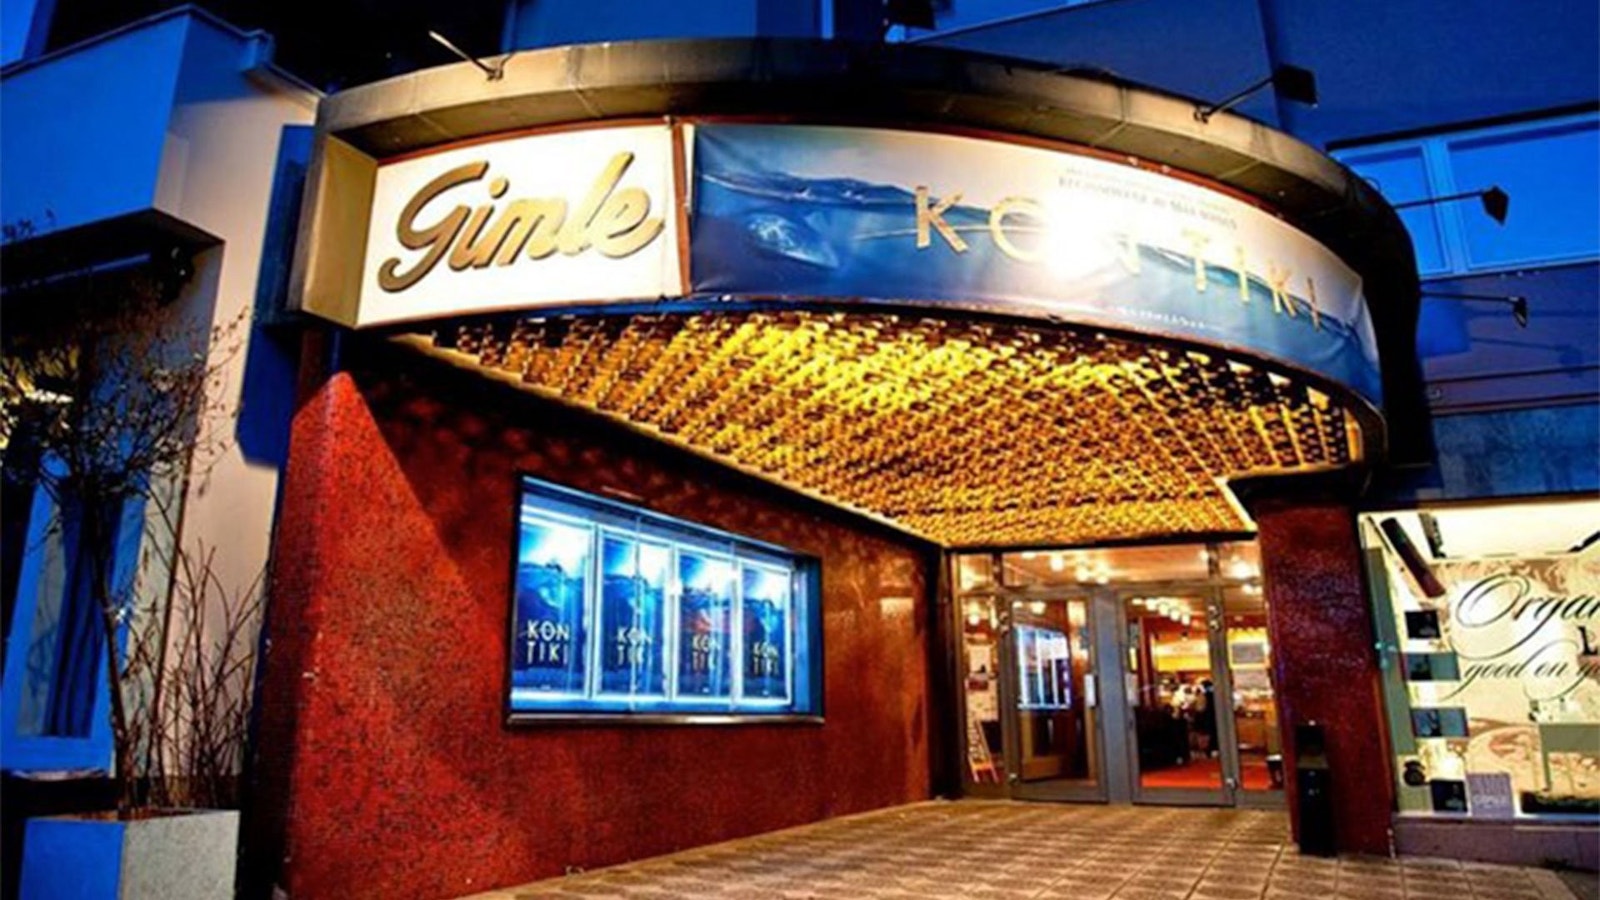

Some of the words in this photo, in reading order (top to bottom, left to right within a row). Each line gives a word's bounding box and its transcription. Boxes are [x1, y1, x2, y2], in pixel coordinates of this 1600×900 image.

[377, 151, 665, 293] Gimle
[1182, 227, 1321, 333] TIKI
[527, 619, 570, 641] KON
[527, 641, 569, 665] TIKI
